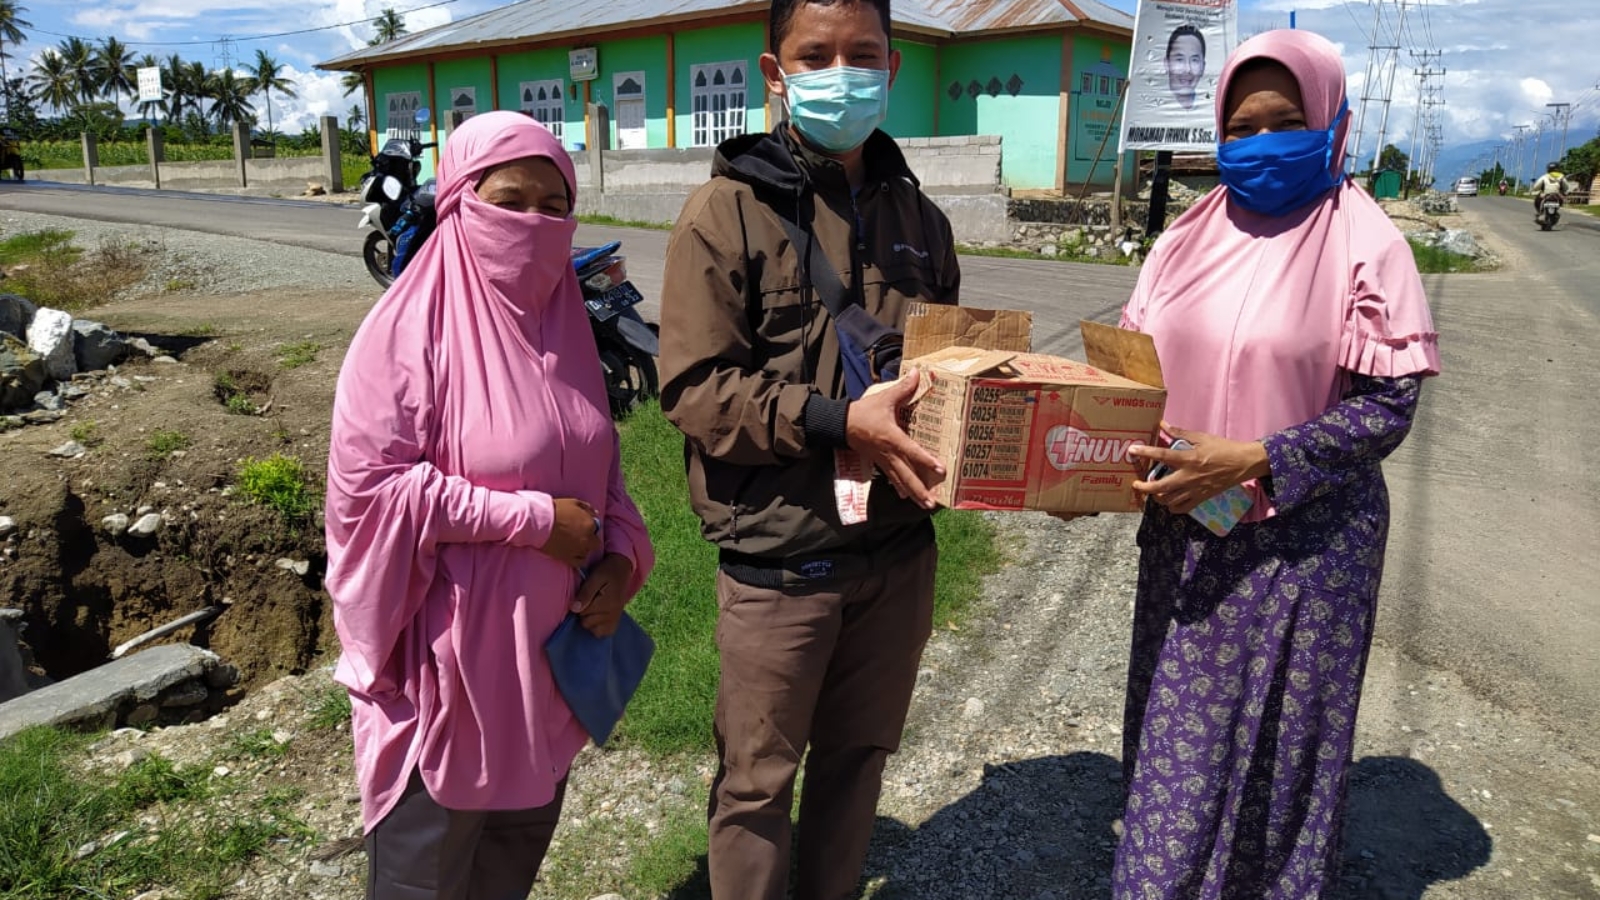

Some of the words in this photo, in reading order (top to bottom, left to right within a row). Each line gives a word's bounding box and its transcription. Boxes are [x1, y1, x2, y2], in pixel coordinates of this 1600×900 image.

[974, 387, 1000, 403] 60255
[1112, 397, 1145, 408] WINGS
[971, 405, 997, 422] 60254
[965, 444, 992, 460] 60257
[962, 462, 990, 479] 61074
[1081, 475, 1122, 487] Family
